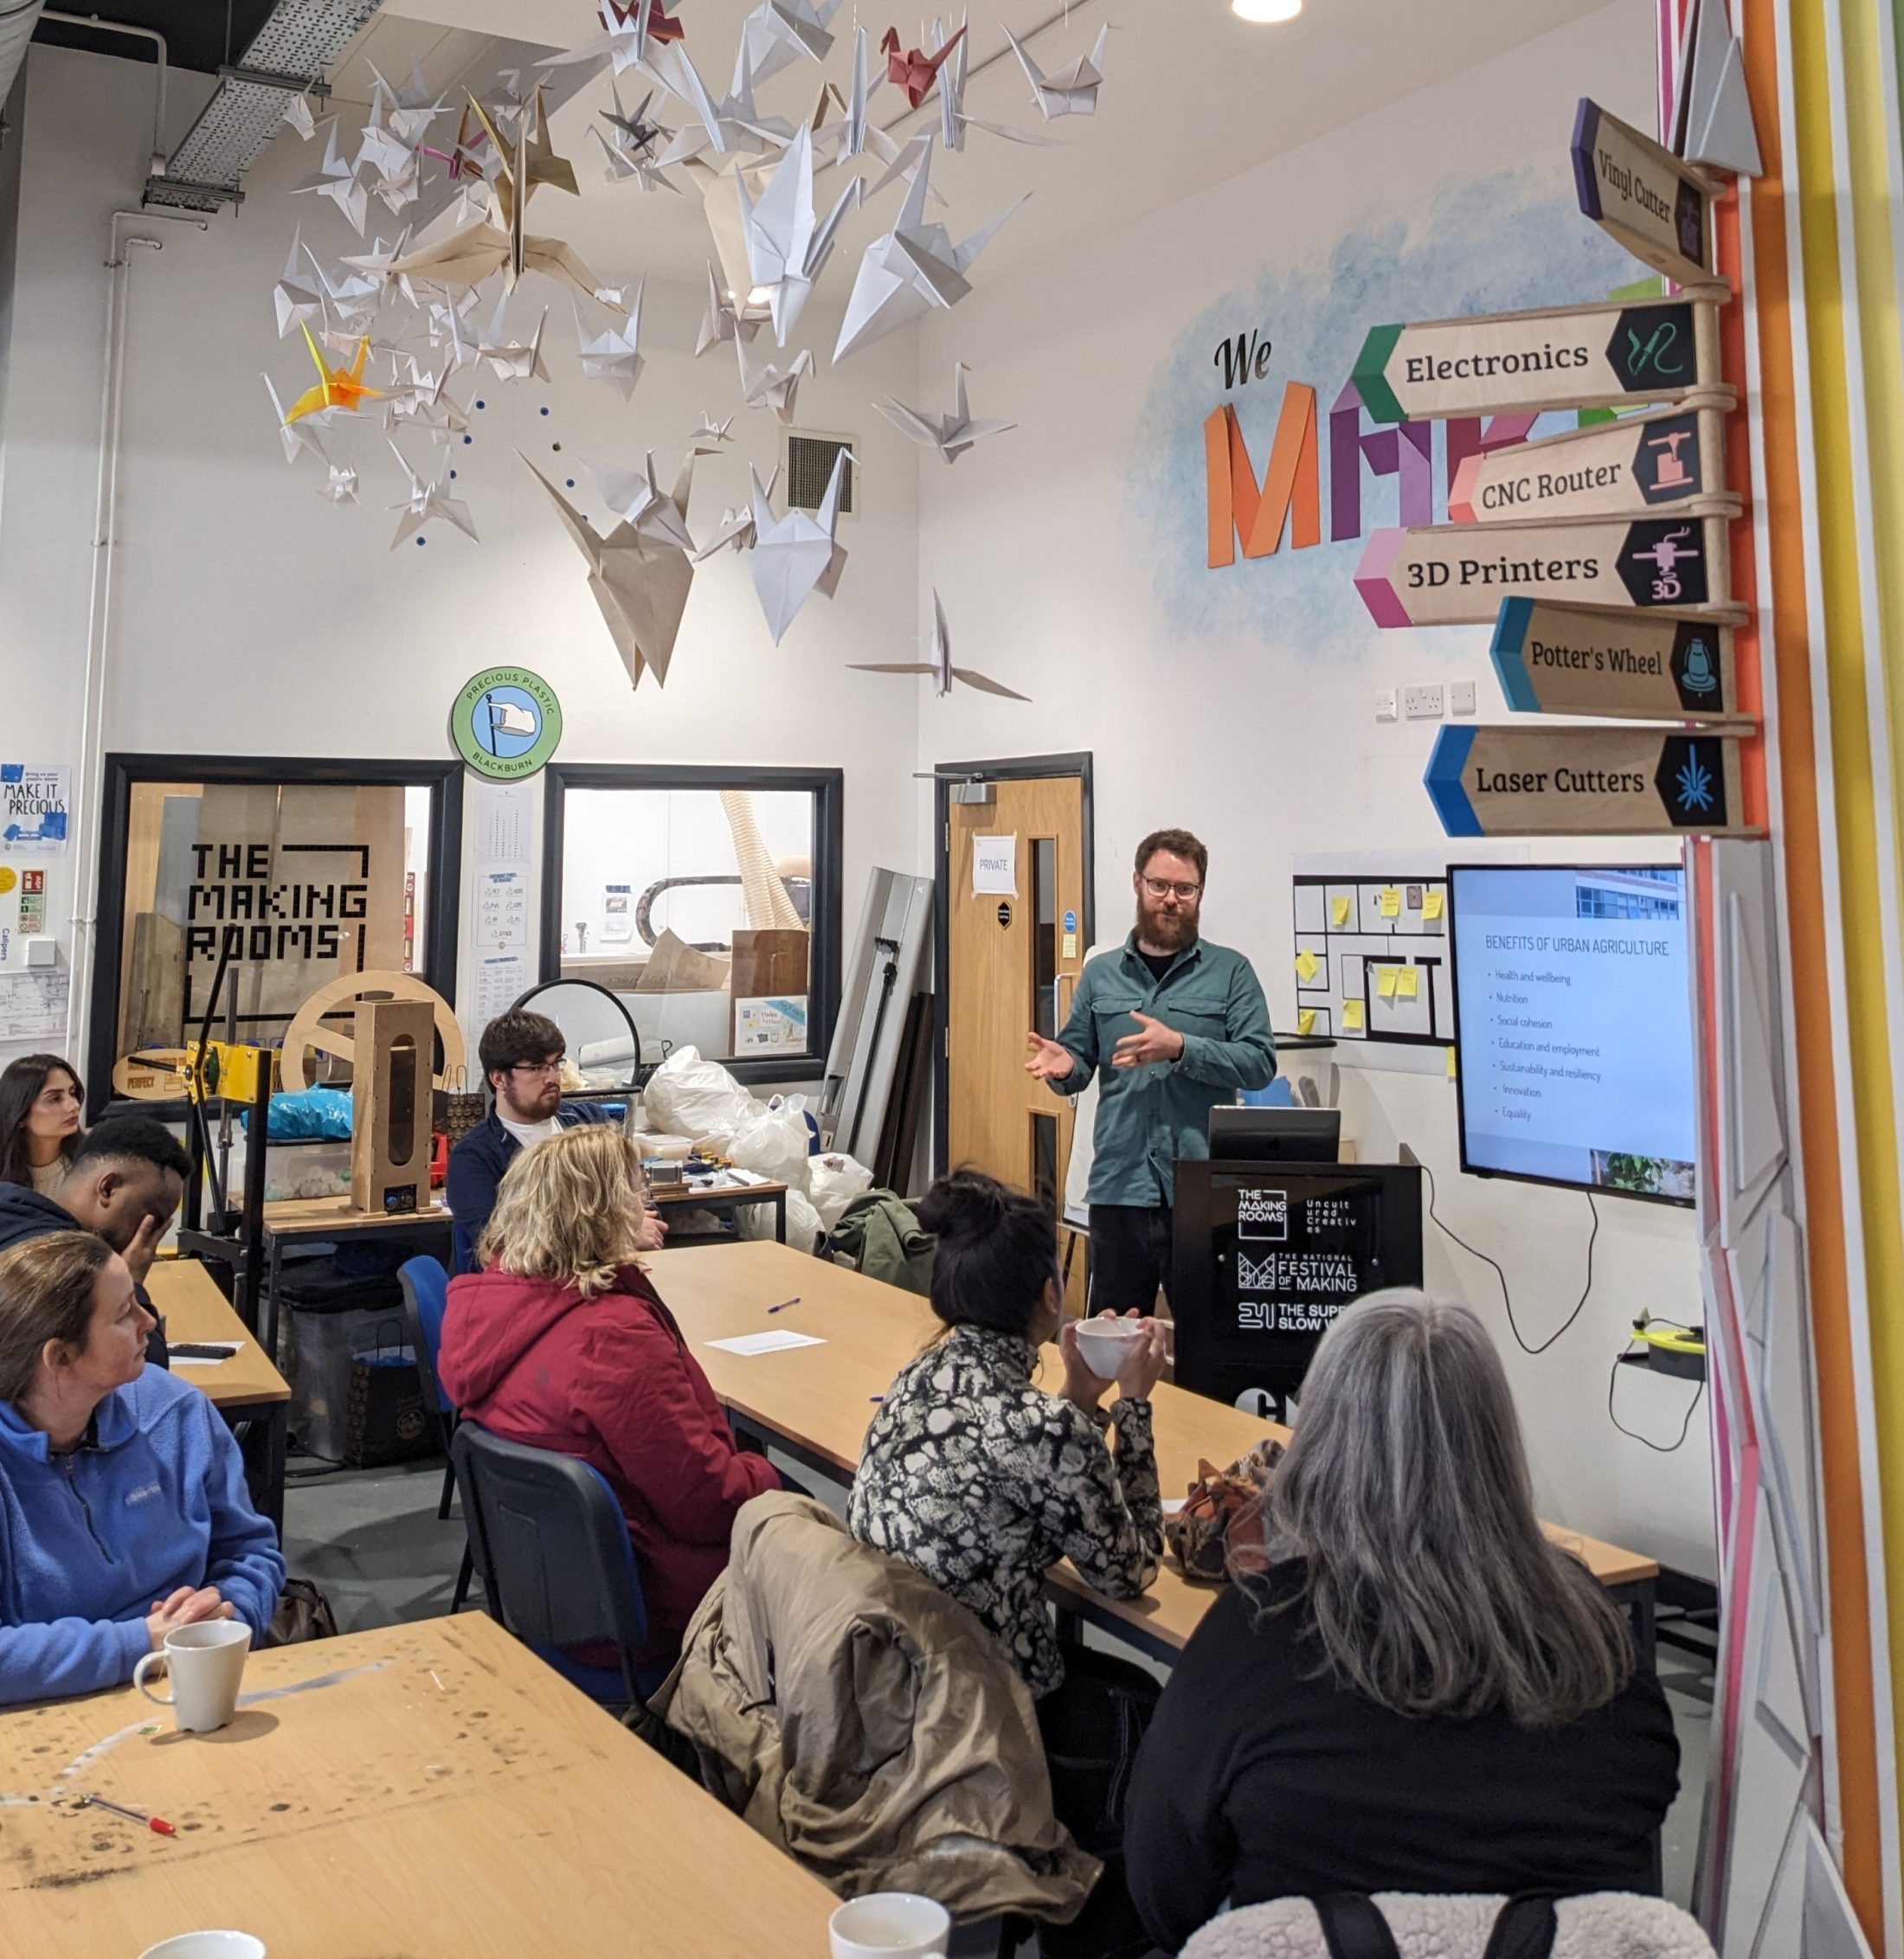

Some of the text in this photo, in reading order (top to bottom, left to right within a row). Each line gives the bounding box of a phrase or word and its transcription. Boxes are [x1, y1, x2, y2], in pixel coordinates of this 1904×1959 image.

[1598, 148, 1670, 223] Vinyl Cutter
[1214, 328, 1271, 390] We
[1405, 344, 1589, 383] Electronics
[1482, 463, 1622, 510] CNC Router
[1407, 556, 1599, 588] 3D Printers
[1651, 579, 1681, 600] 3D
[1531, 641, 1663, 676] Potter's Wheel
[466, 673, 555, 716] PRECIOUS PLASTIC
[472, 752, 533, 772] BLACKBURN
[1476, 768, 1644, 793] Laser Cutters
[4, 783, 58, 799] MAKE IT
[10, 799, 65, 815] PRECIOUS
[191, 844, 268, 878] THE
[979, 858, 1008, 871] PRIVATE
[188, 884, 368, 920] MAKING
[1, 928, 10, 960] Calipers
[186, 925, 339, 961] ROOMS
[1486, 935, 1669, 956] BENEFITS OF URBAN AGRICULTURE
[1496, 969, 1572, 986] Health and wellbeing
[1496, 992, 1528, 1004] Nutrition
[1497, 1015, 1553, 1029] Social cohesion
[1499, 1037, 1600, 1057] Education and employment
[1500, 1061, 1601, 1082] Sustainability and resiliency
[1502, 1084, 1541, 1098] Innovation
[1502, 1107, 1531, 1121] Equality
[1238, 1189, 1262, 1200] THE
[1238, 1200, 1287, 1211] MAKING
[1238, 1211, 1283, 1223] ROOMS
[1278, 1262, 1357, 1277] FESTIVAL
[1278, 1276, 1357, 1292] OF MAKING
[1278, 1303, 1305, 1317] THE
[1278, 1317, 1322, 1331] SLOW
